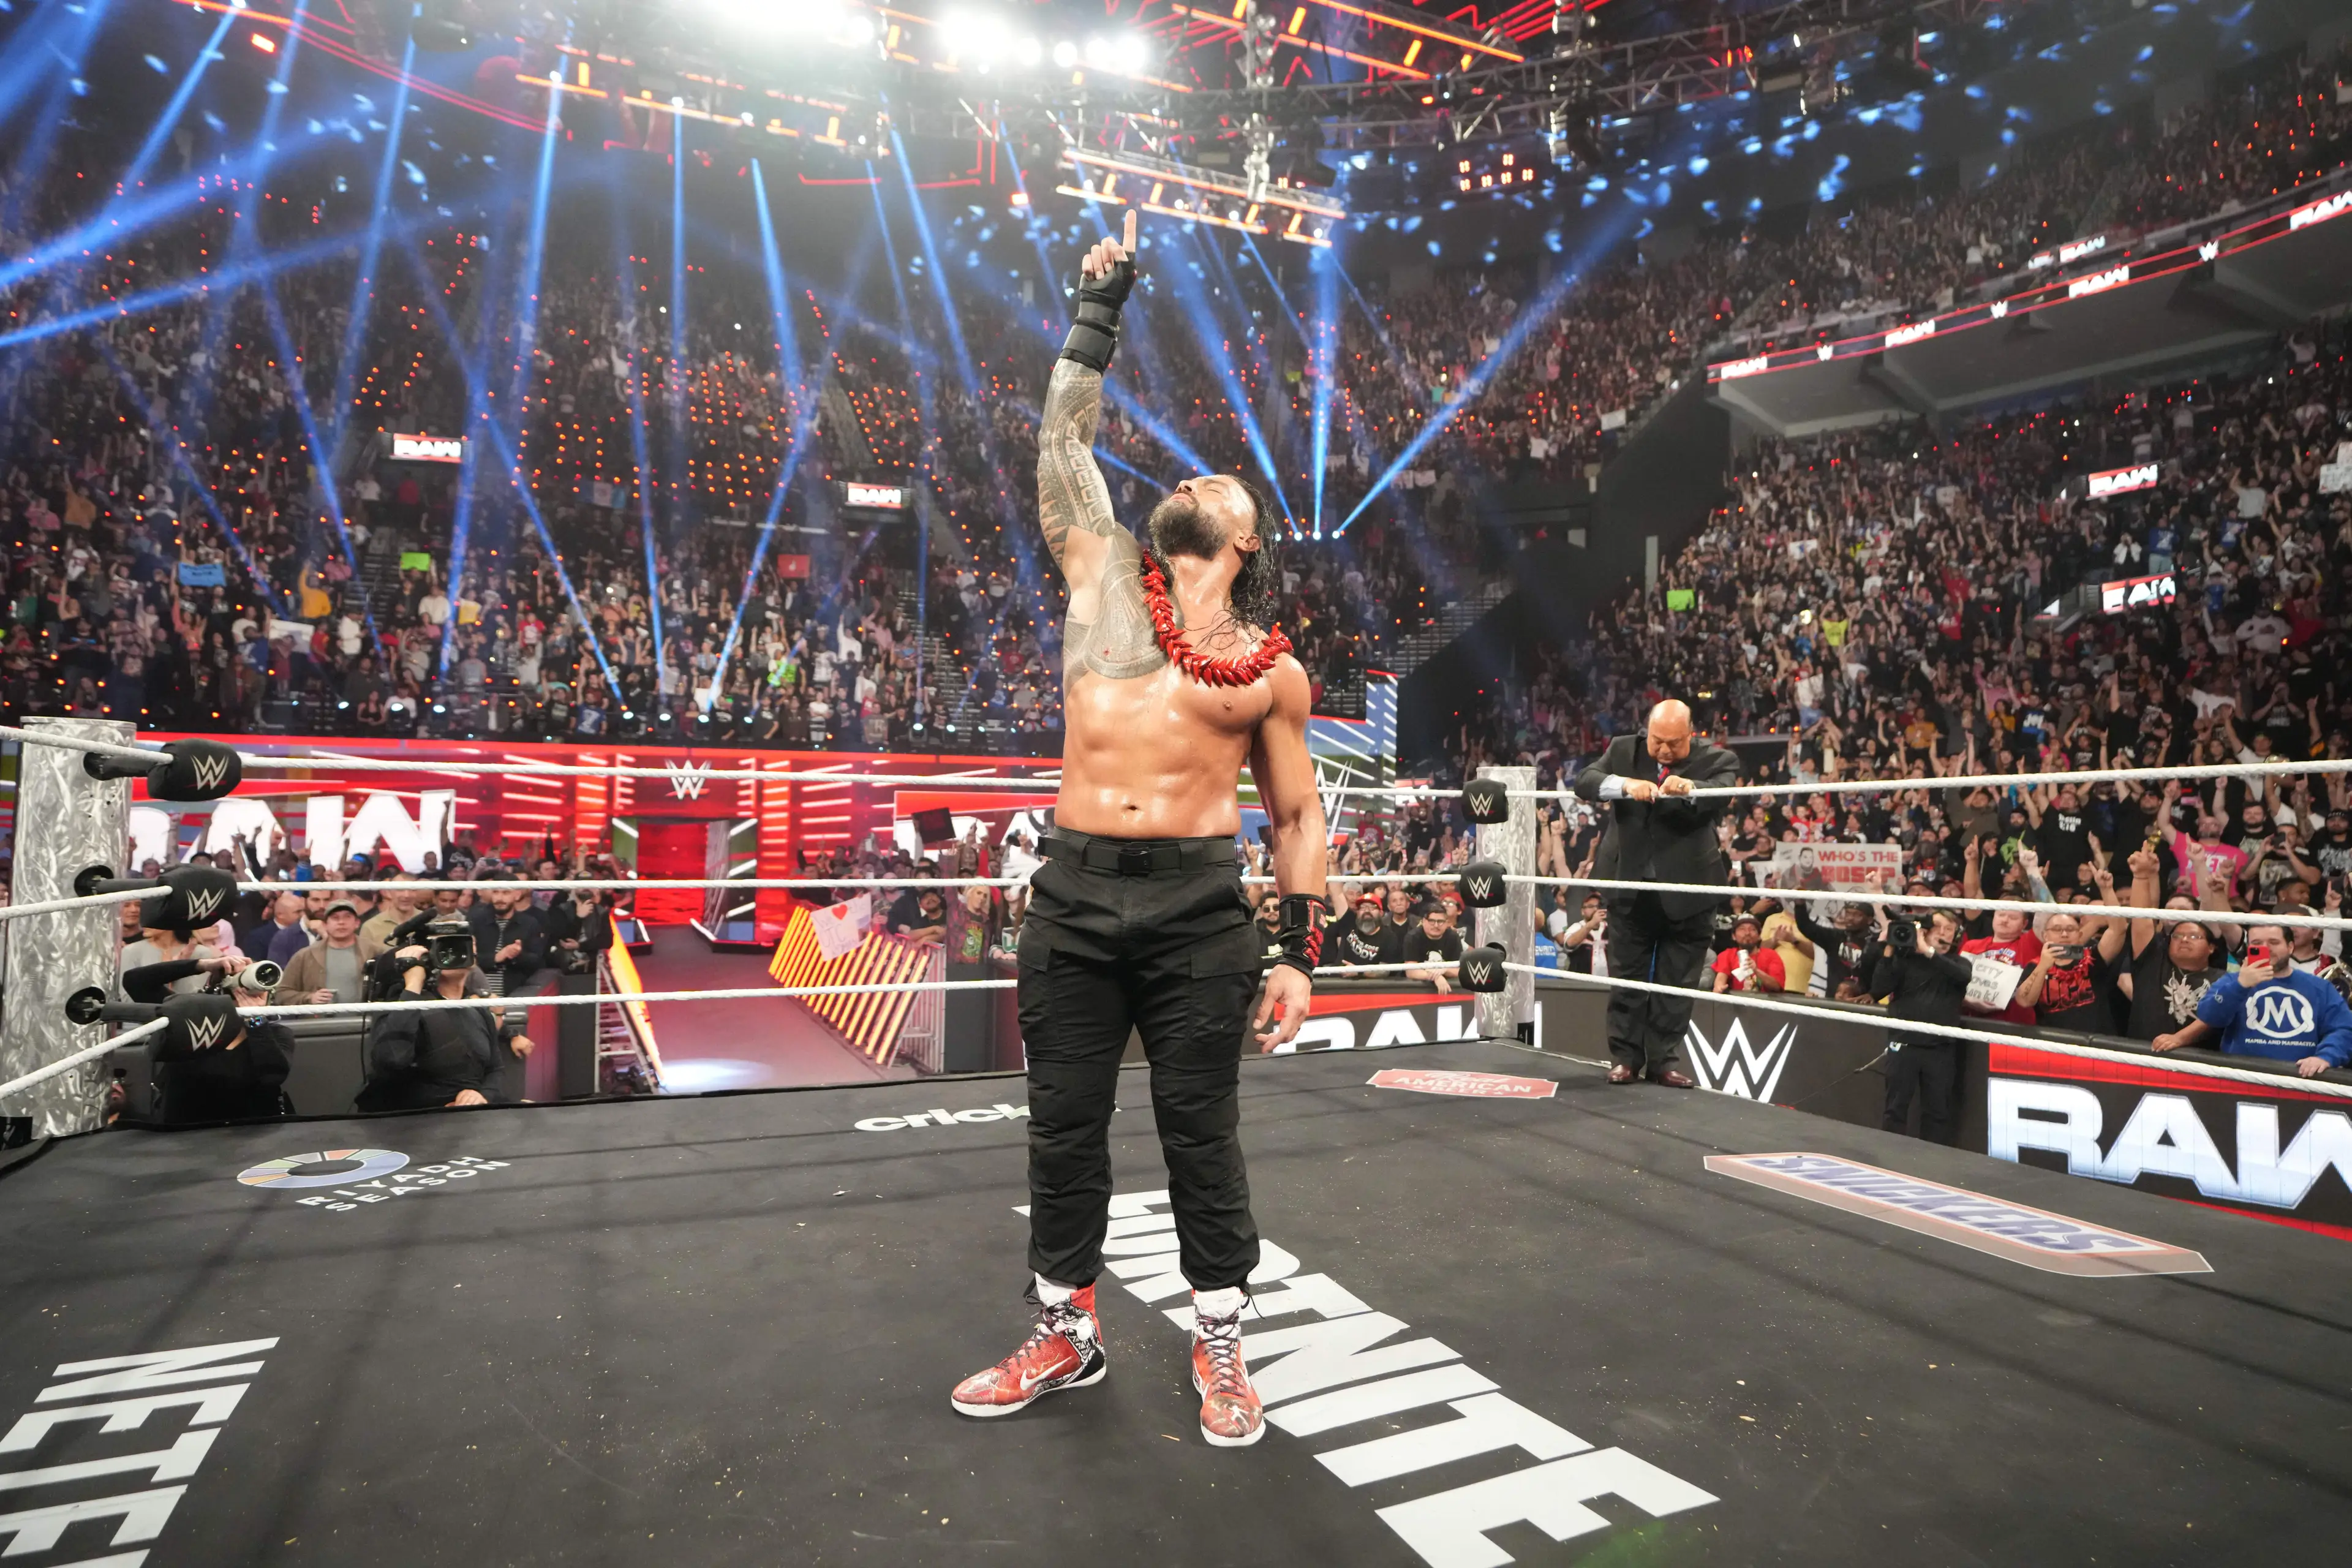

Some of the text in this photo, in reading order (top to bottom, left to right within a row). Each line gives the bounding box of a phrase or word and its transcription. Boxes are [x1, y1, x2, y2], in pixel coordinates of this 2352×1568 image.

[2068, 265, 2129, 299] RAW
[1885, 319, 1936, 348] RAW
[1721, 356, 1767, 380] RAW
[394, 439, 461, 458] RAW
[2089, 464, 2158, 496] RAW
[848, 488, 901, 503] RAW
[1818, 850, 1899, 863] WHO'S THE
[1346, 932, 1378, 961] DADDY
[1966, 986, 2000, 1003] unk!
[1971, 975, 1999, 989] oves
[1392, 1076, 1532, 1093] AMERICAN
[1430, 1086, 1487, 1095] BEER
[854, 1103, 1030, 1132] crick
[295, 1156, 484, 1206] RIYADH
[325, 1160, 511, 1212] SEASON
[1747, 1156, 2145, 1253] SNICKERS
[0, 1336, 281, 1568] NETF
